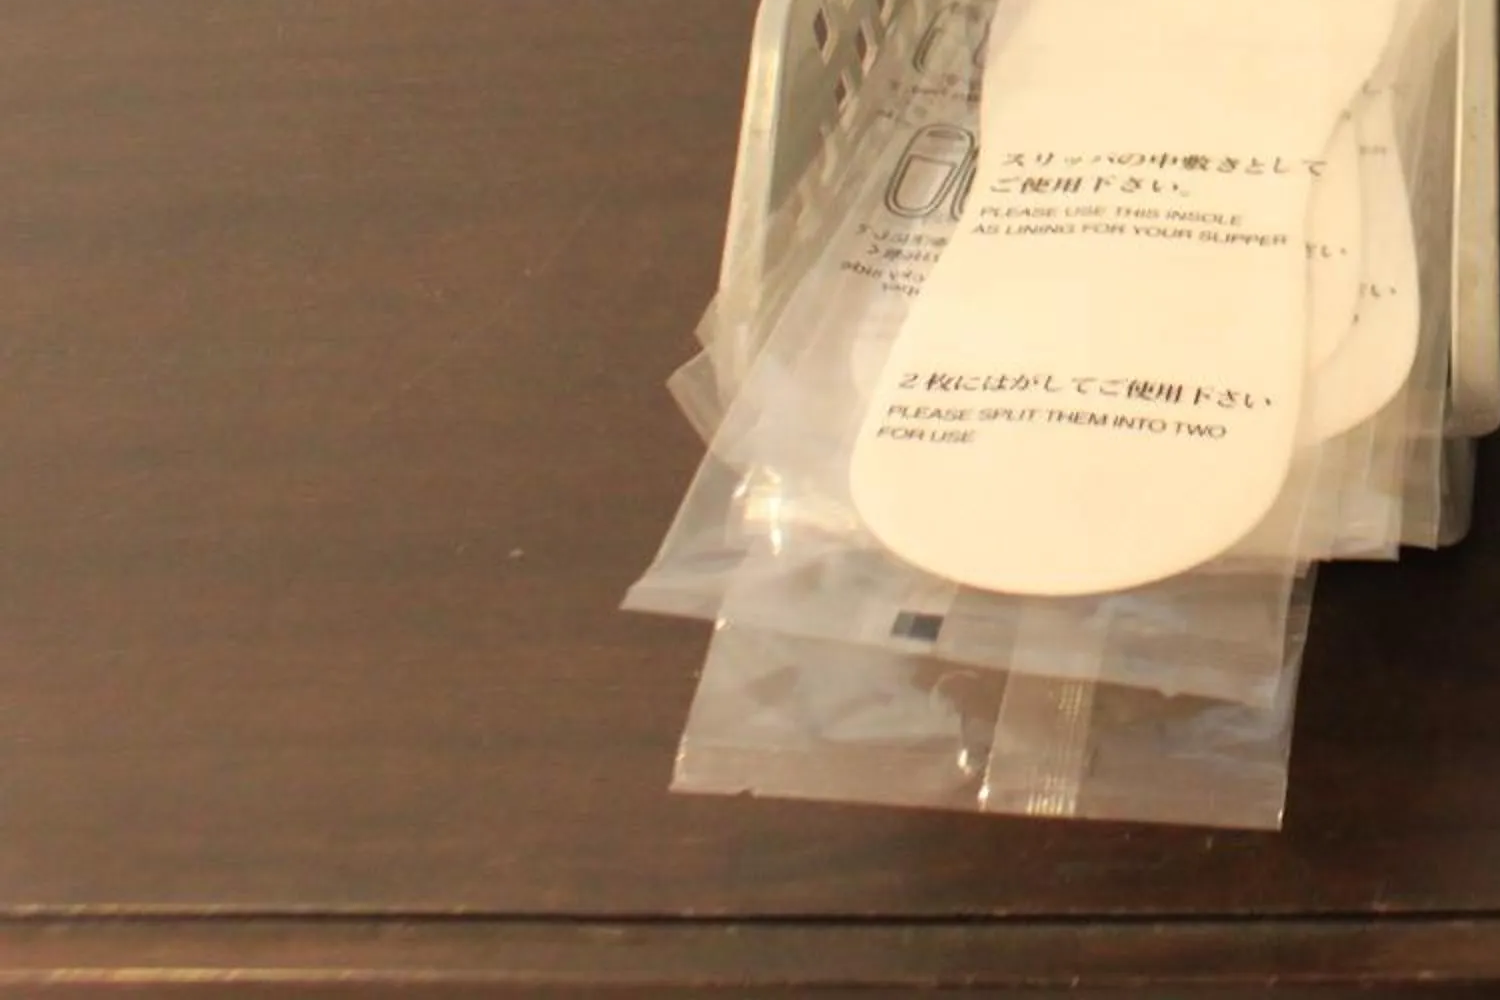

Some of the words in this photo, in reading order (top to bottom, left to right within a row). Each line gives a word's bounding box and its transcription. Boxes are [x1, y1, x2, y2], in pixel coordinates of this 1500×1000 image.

[979, 205, 1056, 219] PLEASE
[1064, 205, 1106, 219] USE
[1115, 205, 1159, 220] THIS
[1165, 209, 1243, 226] INSOLE
[970, 223, 1000, 236] AS
[1004, 223, 1076, 236] LINING
[1081, 223, 1126, 236] FOR
[1133, 226, 1193, 240] YOUR
[1198, 230, 1289, 247] SLIPPER
[886, 404, 974, 423] PLEASE
[978, 406, 1038, 423] SPLIT
[1046, 408, 1107, 427] THEM
[1112, 413, 1167, 434] INTO
[1174, 419, 1228, 440] TWO
[876, 425, 926, 442] FOR
[930, 428, 977, 444] USE
